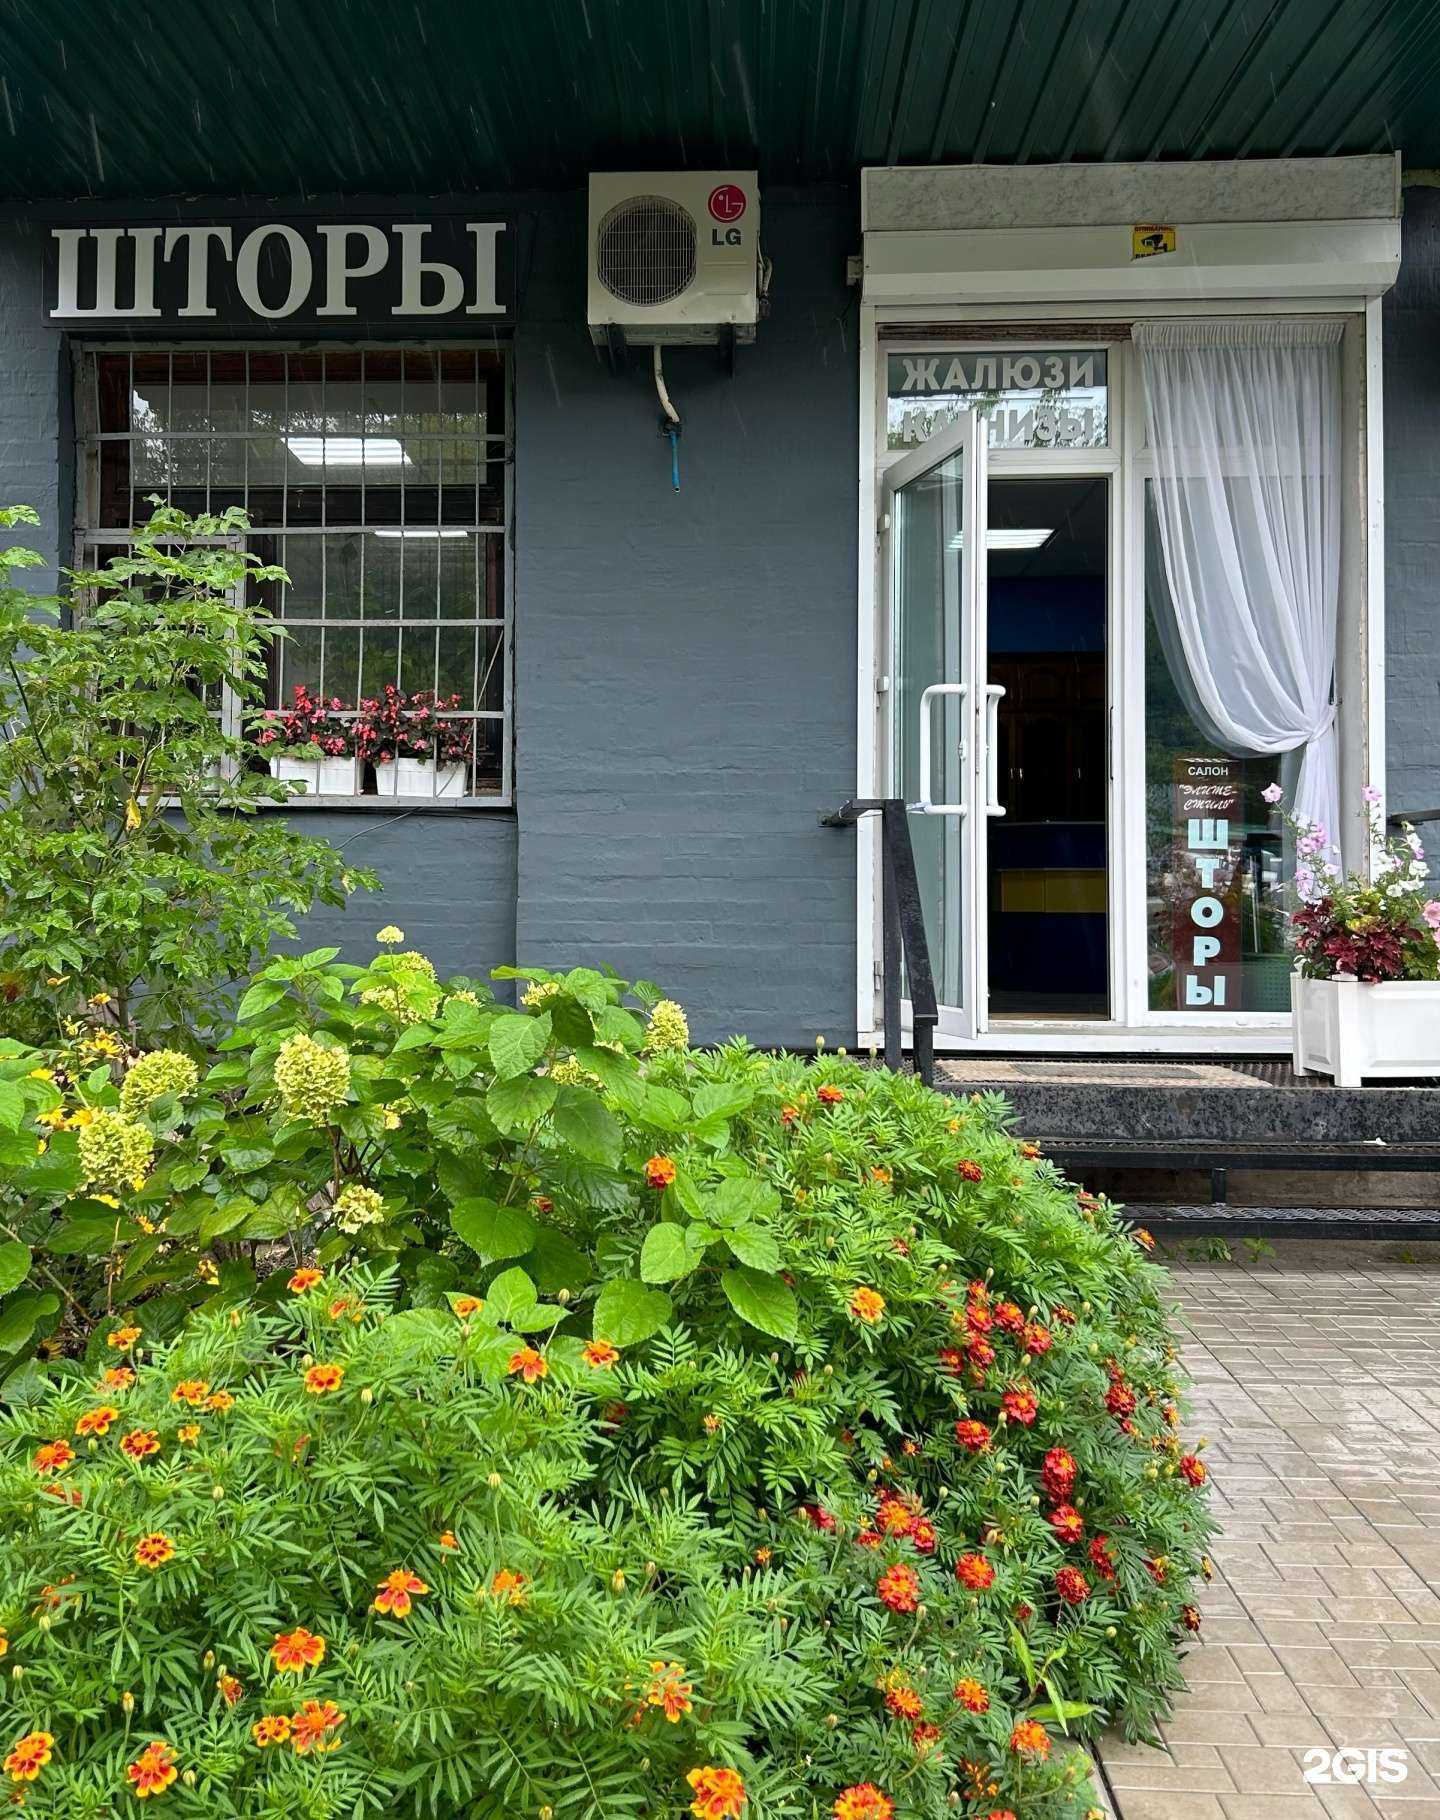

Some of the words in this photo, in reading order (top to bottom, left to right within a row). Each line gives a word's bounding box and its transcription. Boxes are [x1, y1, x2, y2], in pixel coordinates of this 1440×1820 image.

[712, 228, 742, 246] LG
[49, 222, 507, 319] ШТОРЫ
[901, 356, 1095, 391] ЖАЛЮЗИ
[1188, 766, 1229, 776] САЛОН
[1186, 819, 1228, 1005] ШТОРЫ
